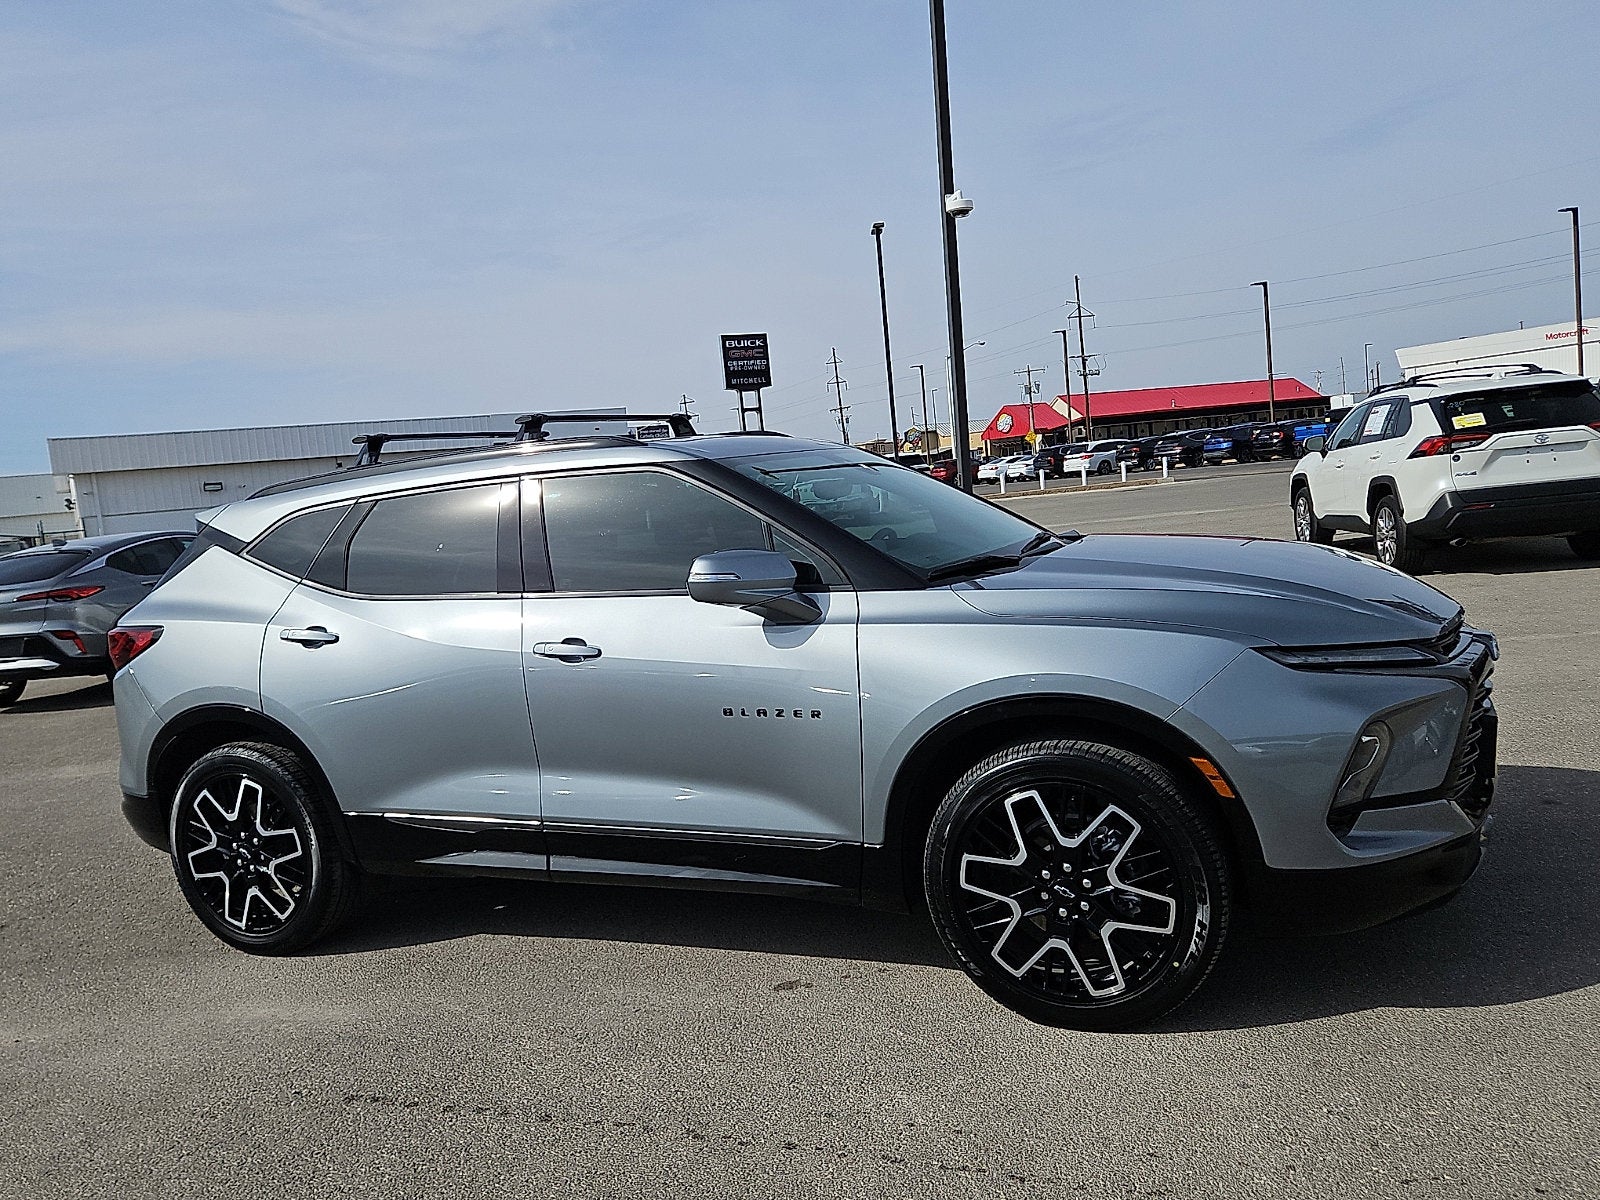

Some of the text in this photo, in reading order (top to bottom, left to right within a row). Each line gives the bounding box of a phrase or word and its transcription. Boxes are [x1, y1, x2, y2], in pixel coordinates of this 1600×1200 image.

[1545, 328, 1589, 340] Motorcrft
[726, 339, 765, 347] BUICK
[729, 349, 764, 357] GMC
[722, 707, 821, 719] BLAZER
